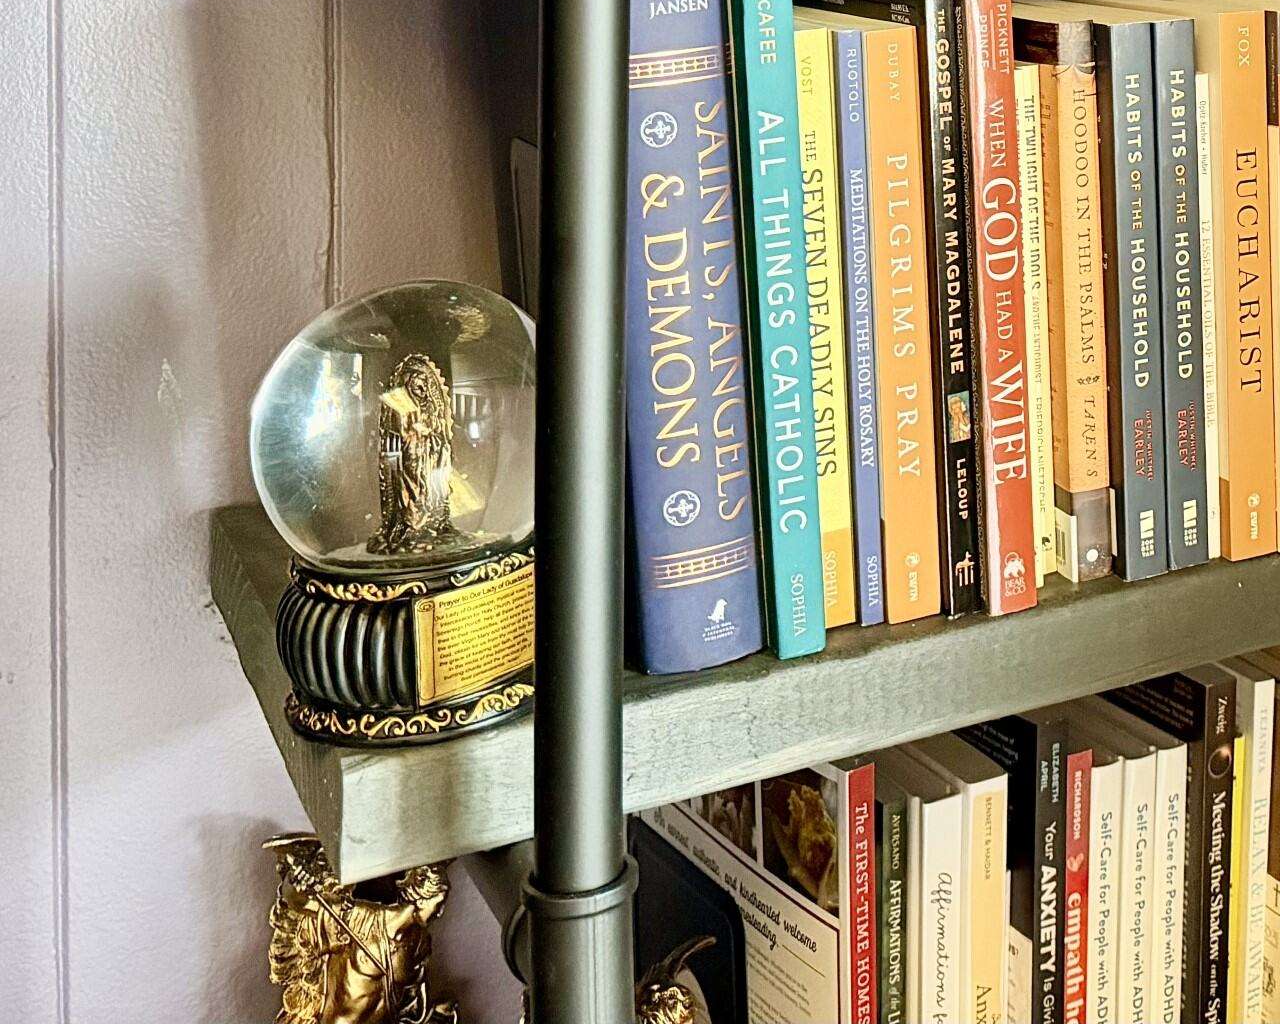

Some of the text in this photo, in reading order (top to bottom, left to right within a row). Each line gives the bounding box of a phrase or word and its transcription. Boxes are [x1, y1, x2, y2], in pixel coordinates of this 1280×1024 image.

[757, 110, 787, 175] ALL
[978, 14, 990, 70] PRINCE
[996, 3, 1011, 75] PICKNETT
[640, 175, 701, 469] & DEMONS
[694, 101, 748, 523] SAINTS, ANGELS
[761, 189, 795, 328] THINGS
[800, 55, 837, 478] VOST THE SEVEN DEADLY SINS
[849, 168, 875, 468] MEDITATIONS ON THE HOLY ROSARY
[887, 152, 920, 478] PILGRIMS PRAY
[936, 9, 968, 520] THE GOSPEL OF MARY MAGDALENE LELOUP
[982, 98, 1028, 487] WHEN GOD HAD A WIFE
[1073, 87, 1095, 365] HOODOO IN THE PSALMS
[1125, 73, 1150, 388] HABITS OF THE HOUSEHOLD
[1236, 26, 1263, 394] FOX EUCHARIST
[769, 344, 808, 534] CATHOLIC
[1135, 418, 1146, 476] EARLEY
[789, 573, 807, 636] SOPHIA
[739, 882, 781, 926] kindhearted
[784, 919, 817, 953] welcome
[855, 803, 871, 950] The FIRST-TIME
[1041, 821, 1057, 974] Your ANXIETY
[1065, 769, 1085, 996] RICHARDSON empath
[1161, 793, 1179, 1024] Self-Care for People with ADHD
[1208, 696, 1228, 961] Zweig Meeting the Shadow
